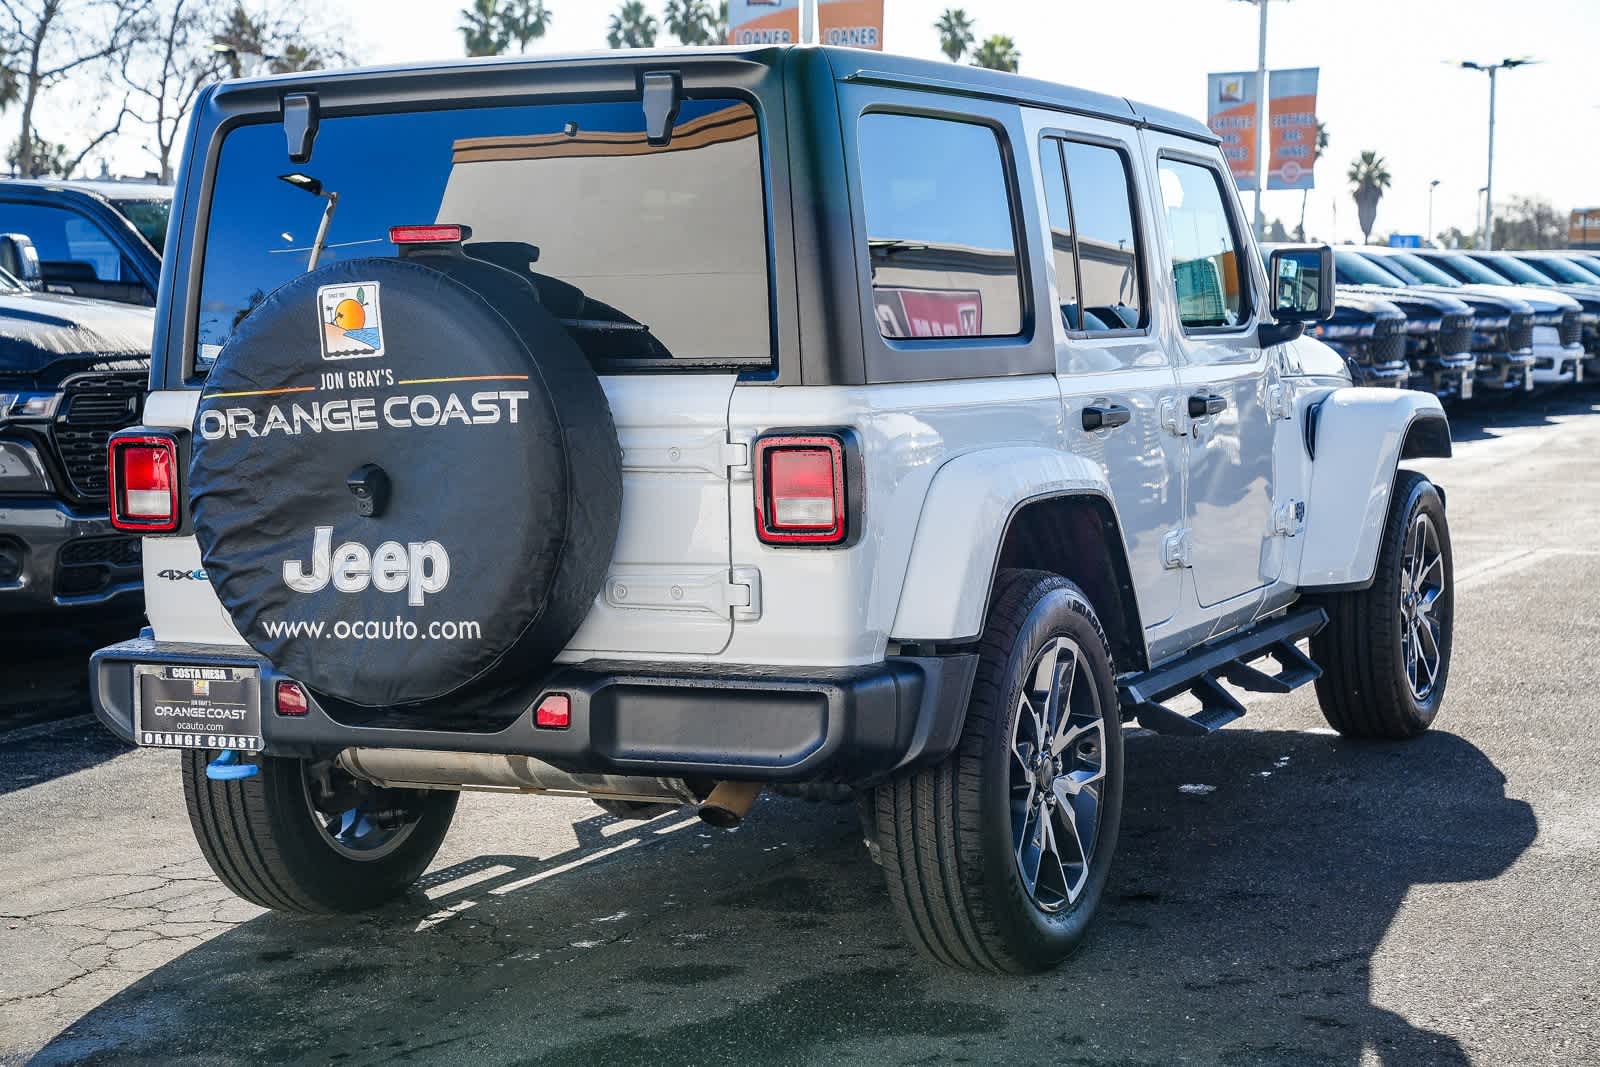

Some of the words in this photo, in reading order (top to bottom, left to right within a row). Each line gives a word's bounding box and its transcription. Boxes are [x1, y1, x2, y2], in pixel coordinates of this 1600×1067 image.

[825, 28, 878, 45] LOANER
[320, 373, 344, 390] JON
[348, 368, 394, 388] GRAY'S
[200, 398, 379, 440] ORANGE
[383, 390, 529, 428] COAST
[282, 525, 450, 606] Jeep
[262, 615, 482, 641] www.ocauto.com
[172, 668, 200, 679] COSTA
[201, 669, 226, 680] MESA
[154, 706, 206, 718] ORANGE
[206, 707, 247, 720] COAST
[176, 722, 224, 731] ocauto.com
[144, 733, 202, 746] ORANGE
[207, 735, 256, 749] COAST
